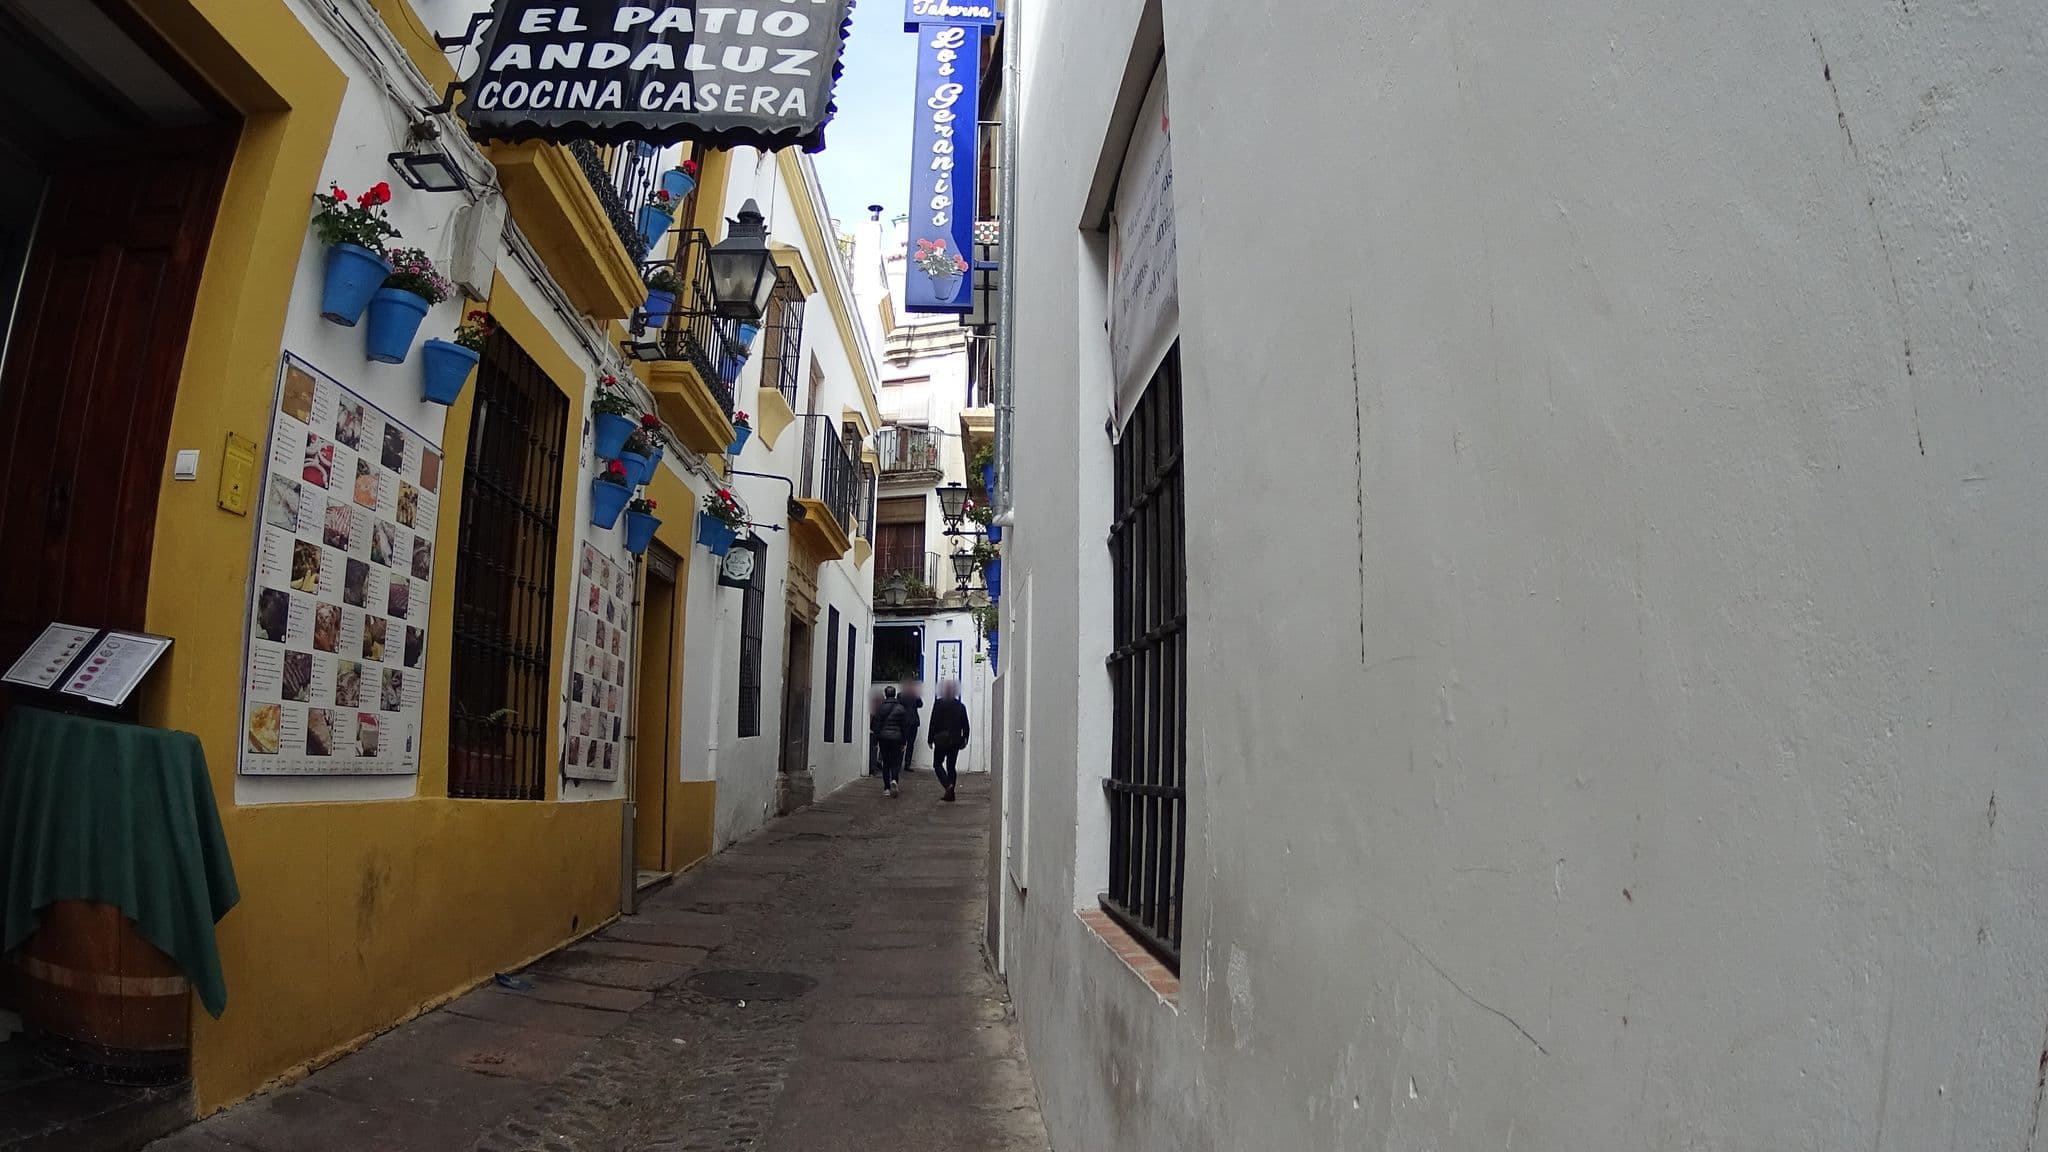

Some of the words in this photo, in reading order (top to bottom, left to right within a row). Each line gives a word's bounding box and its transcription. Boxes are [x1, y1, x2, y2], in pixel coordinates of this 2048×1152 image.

[518, 8, 588, 35] EL
[613, 7, 811, 38] PATIO
[912, 0, 992, 18] Taberna
[489, 42, 820, 77] ANDALUZ
[930, 27, 966, 76] Los
[477, 80, 623, 111] COCINA
[640, 80, 808, 117] CASERA
[927, 83, 964, 227] Geranios
